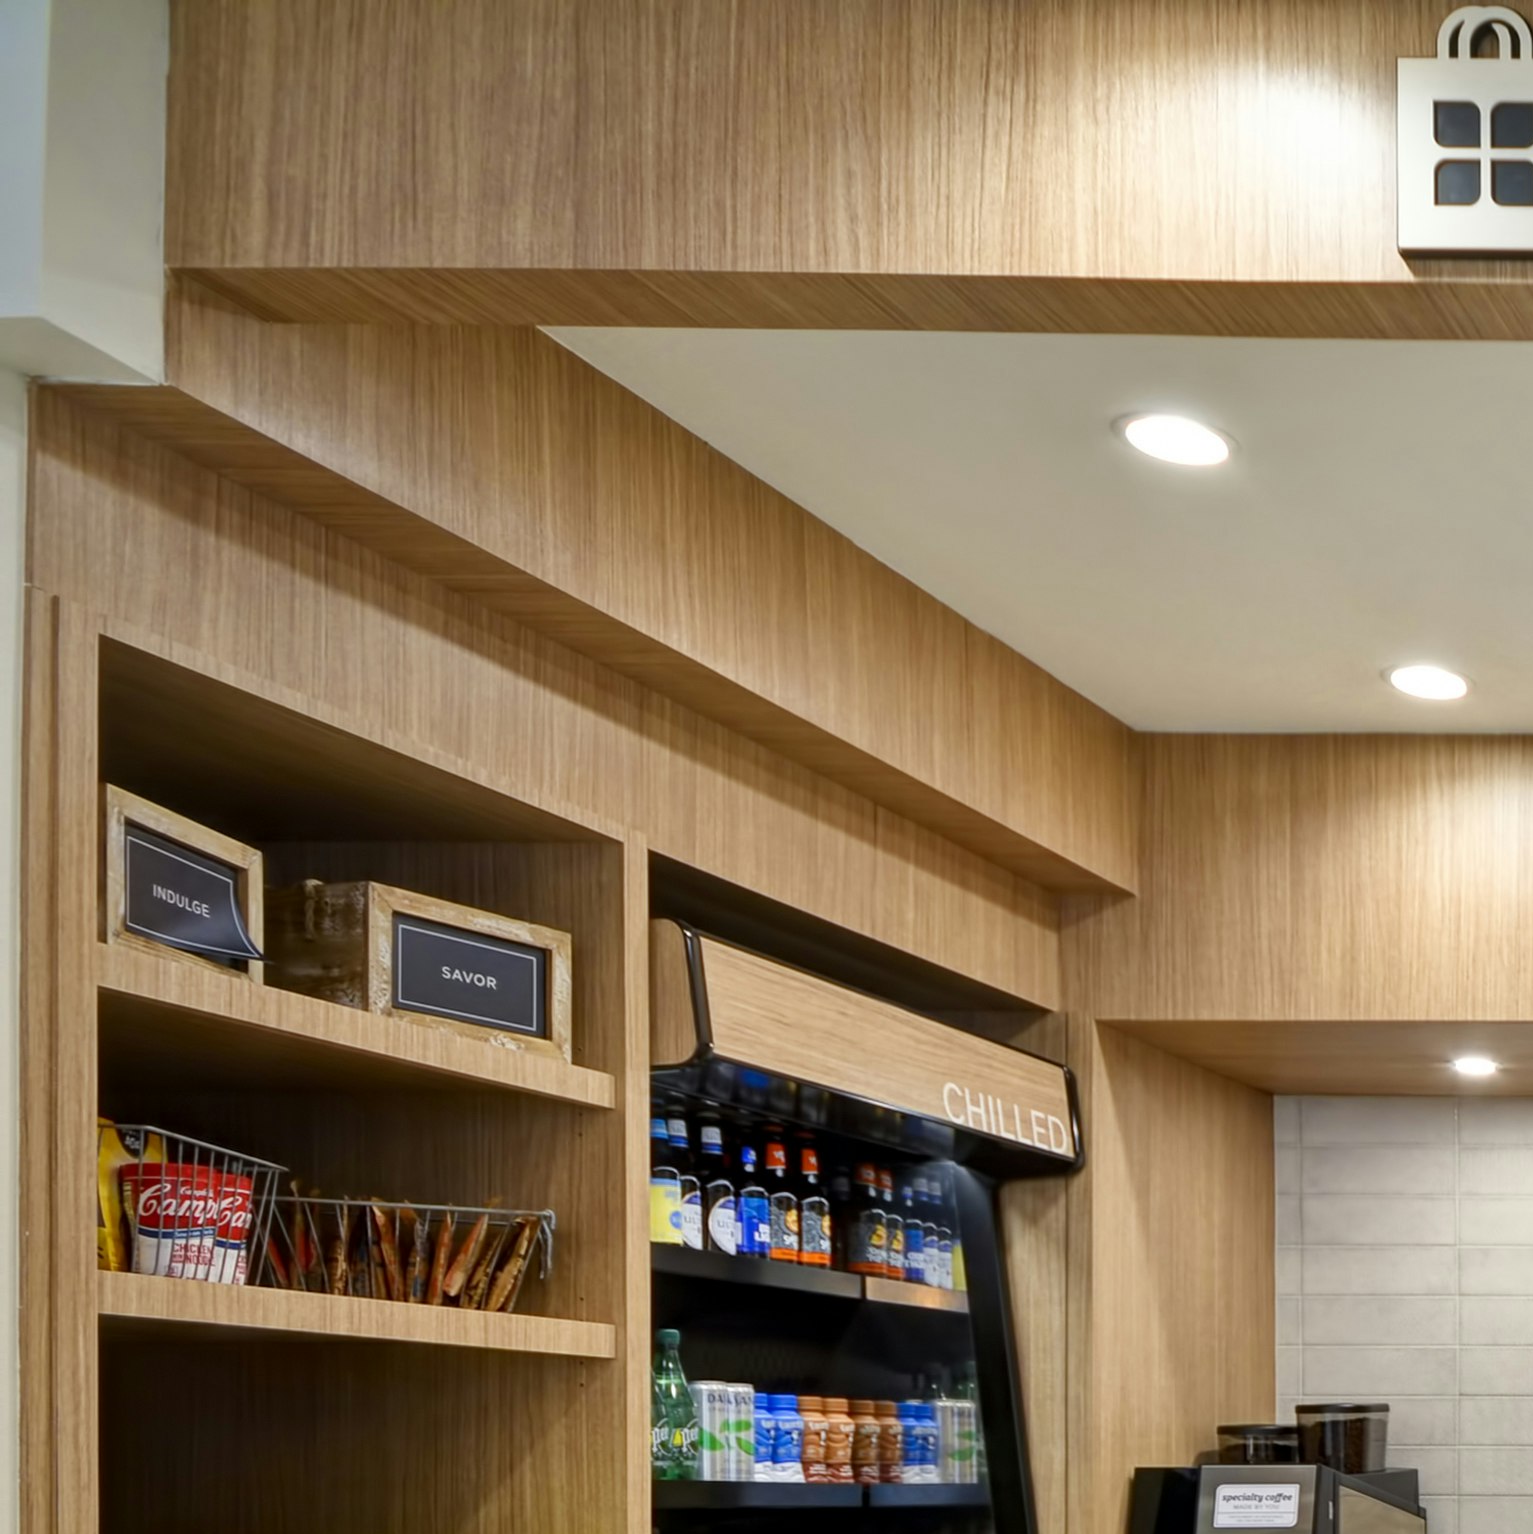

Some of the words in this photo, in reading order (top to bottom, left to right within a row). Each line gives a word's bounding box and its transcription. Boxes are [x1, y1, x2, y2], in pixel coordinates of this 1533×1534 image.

[152, 884, 211, 919] INDULGE
[441, 966, 497, 990] SAVOR
[942, 1081, 1067, 1153] CHILLED
[1222, 1493, 1263, 1503] specialty
[1265, 1493, 1292, 1503] coffee
